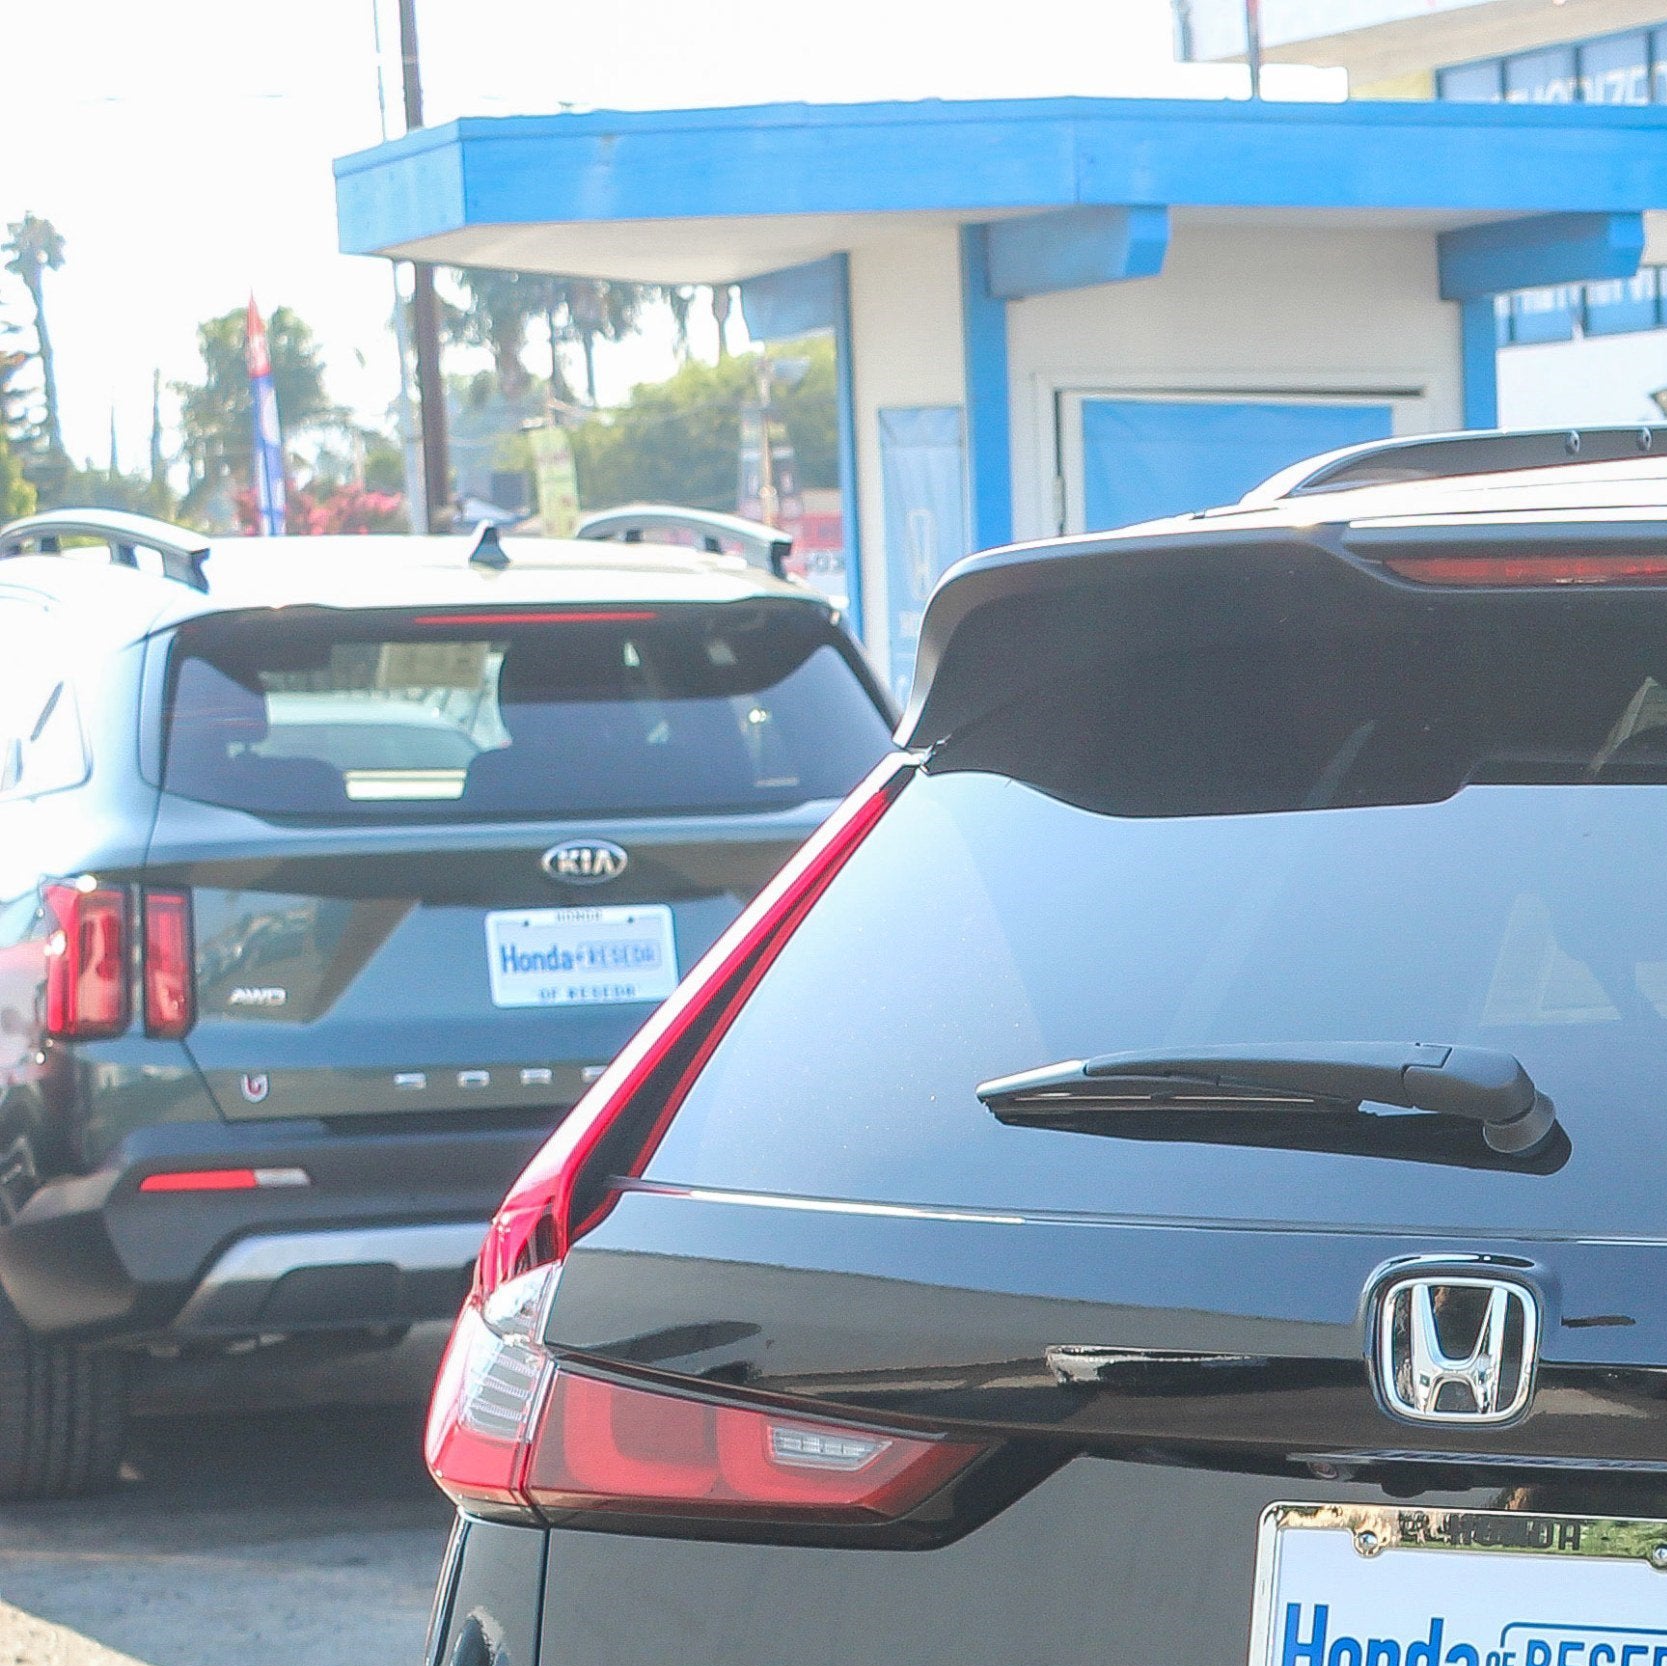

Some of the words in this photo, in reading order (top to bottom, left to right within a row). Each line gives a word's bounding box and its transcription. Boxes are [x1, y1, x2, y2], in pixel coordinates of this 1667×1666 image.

[554, 846, 619, 877] KIA
[501, 943, 574, 973] Honda
[228, 986, 288, 1006] AWD
